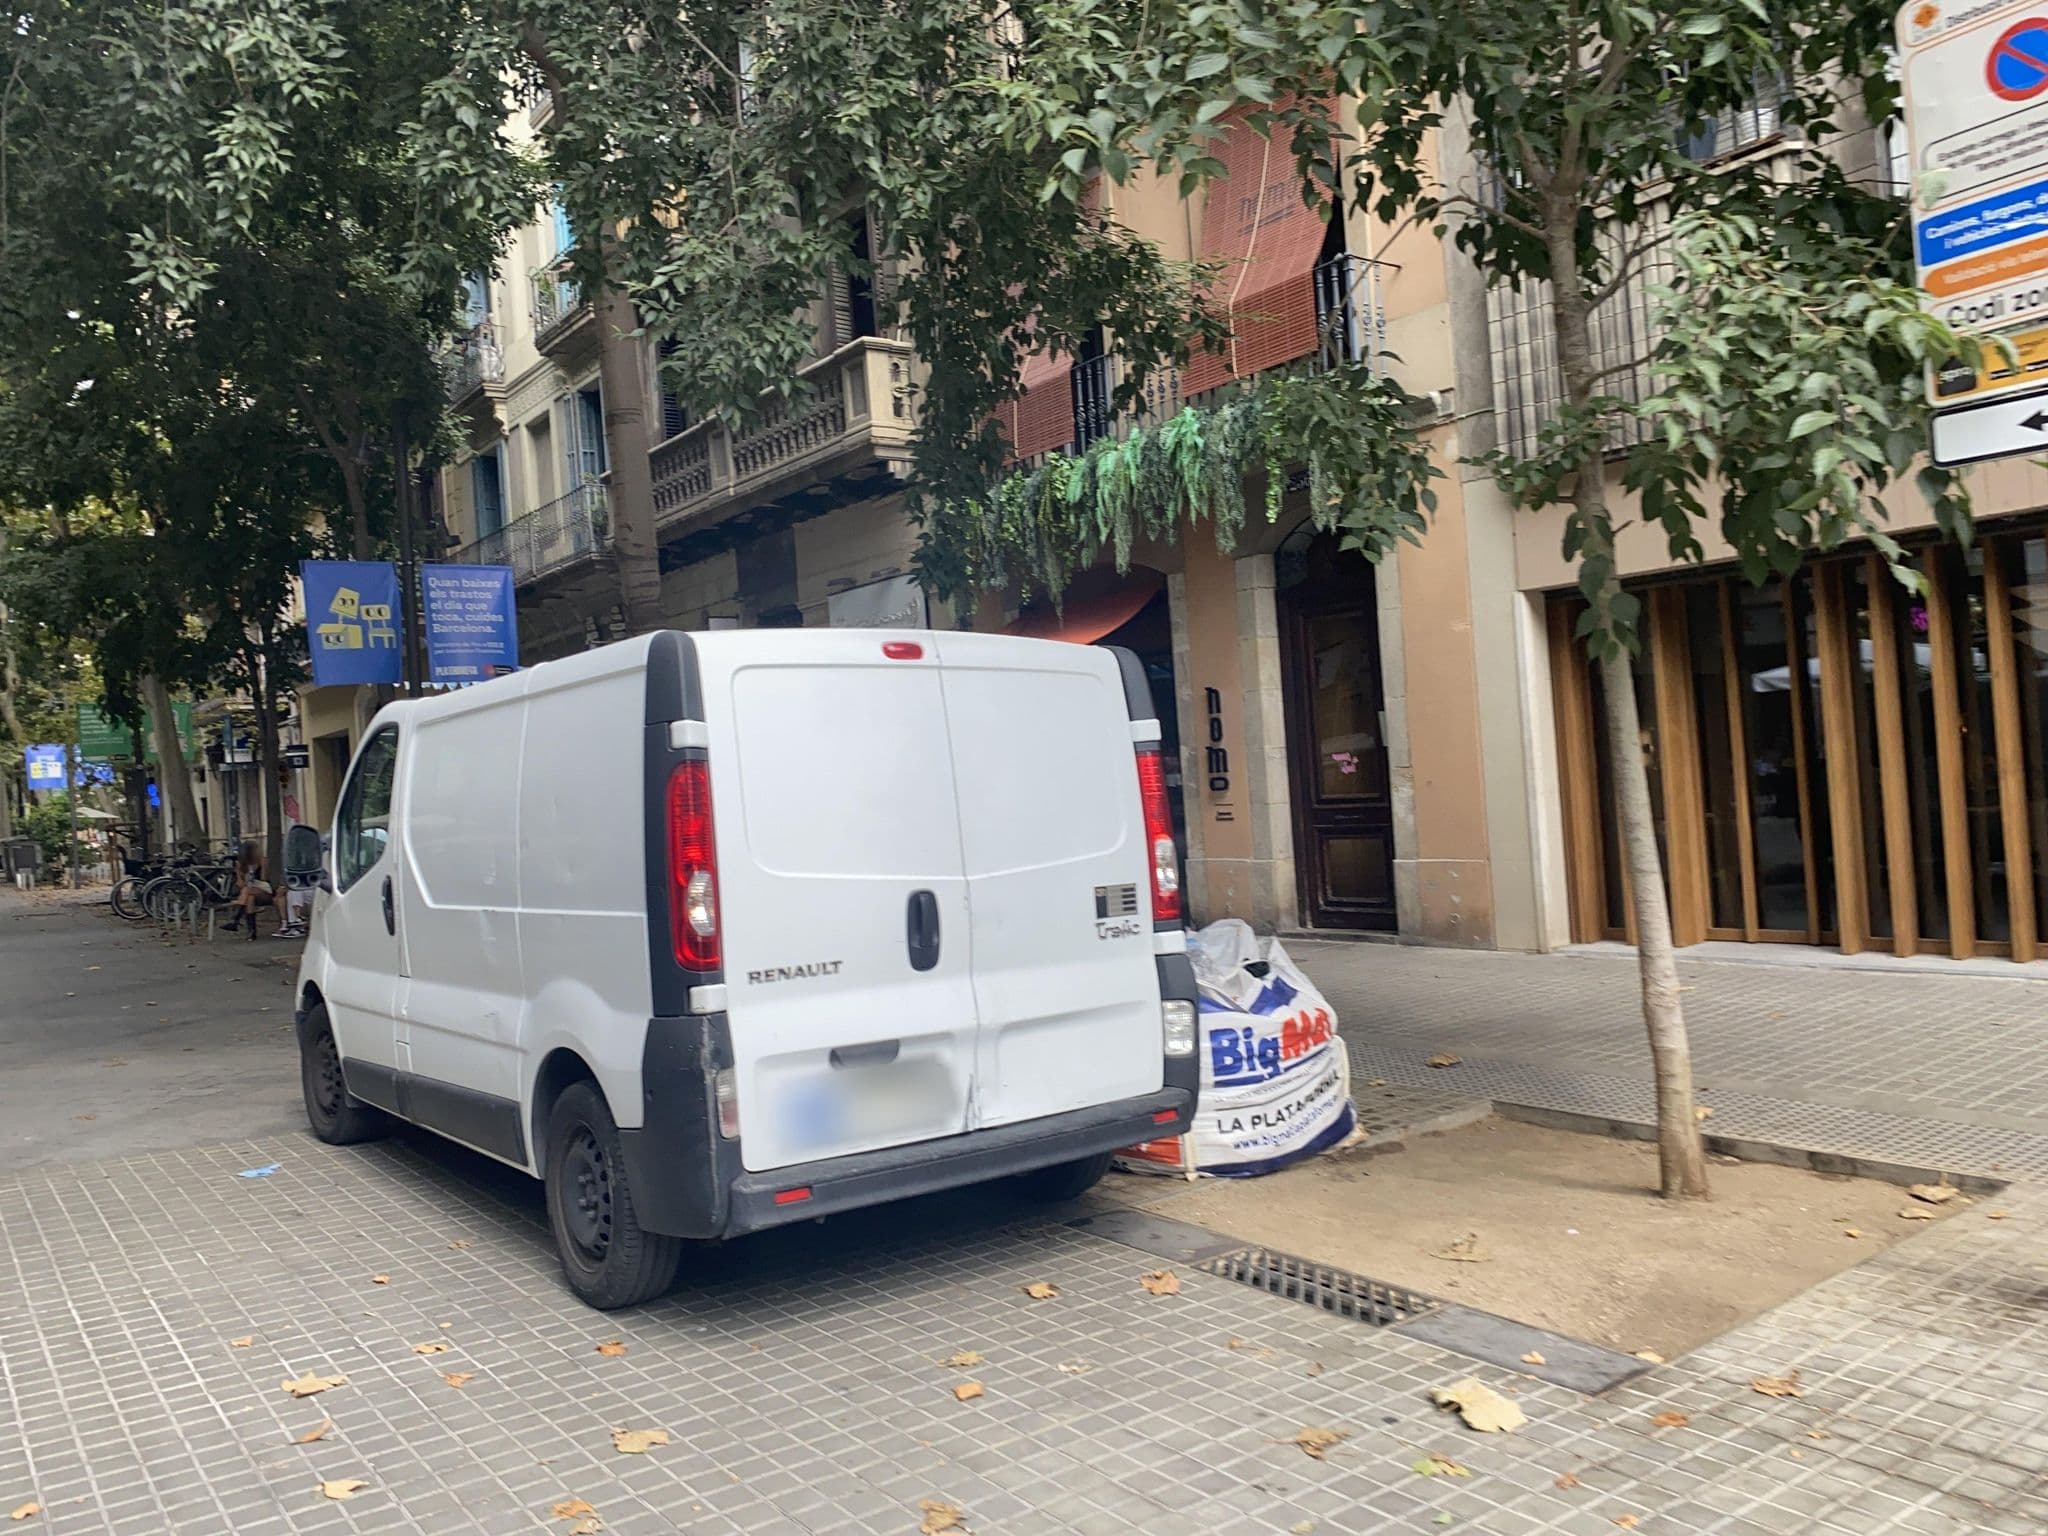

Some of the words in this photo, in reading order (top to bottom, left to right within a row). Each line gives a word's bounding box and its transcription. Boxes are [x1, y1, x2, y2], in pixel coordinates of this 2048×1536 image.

[1946, 291, 2004, 329] Codi
[428, 577, 460, 588] Quan
[430, 589, 447, 598] els
[450, 590, 493, 599] trastos
[430, 599, 442, 609] el
[465, 602, 488, 611] que
[432, 623, 497, 633] Barcelona.
[1204, 686, 1229, 792] nomo
[747, 960, 843, 985] RENAULT
[1217, 1117, 1244, 1134] LA
